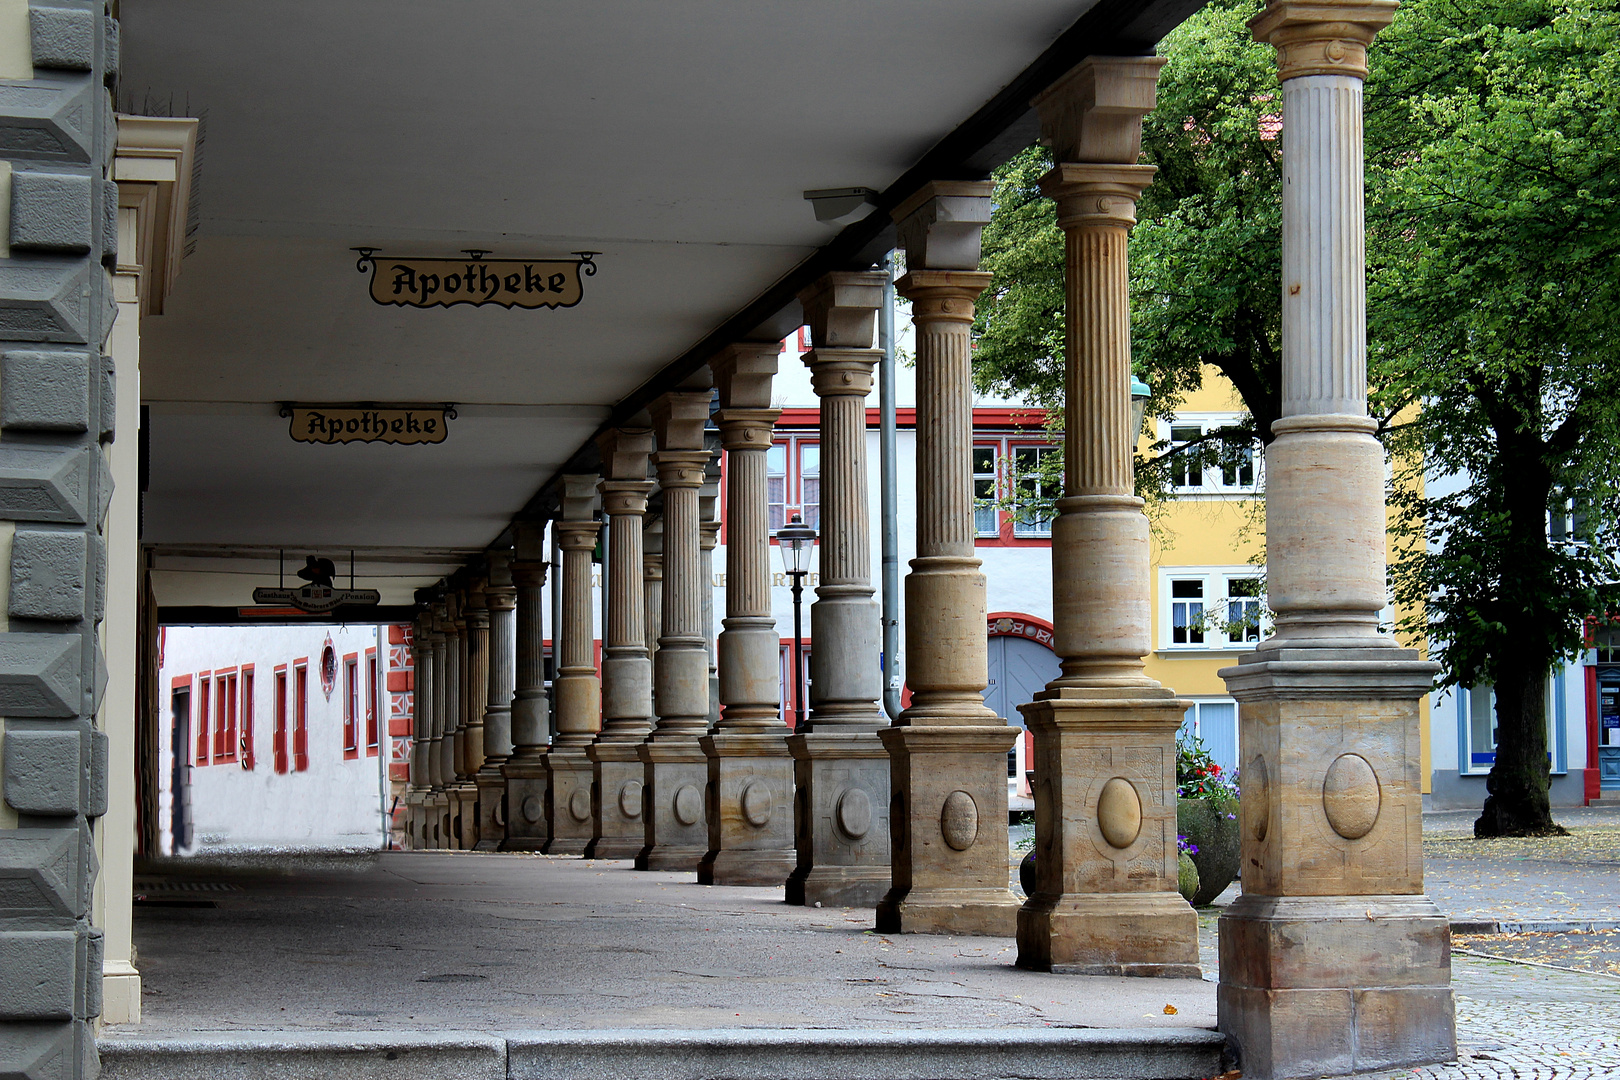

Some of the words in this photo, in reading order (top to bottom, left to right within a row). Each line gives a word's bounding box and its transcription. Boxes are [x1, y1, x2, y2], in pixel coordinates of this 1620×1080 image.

[390, 264, 566, 304] Apotheke
[306, 411, 437, 442] Apotheke
[257, 591, 290, 599] Gasthaus
